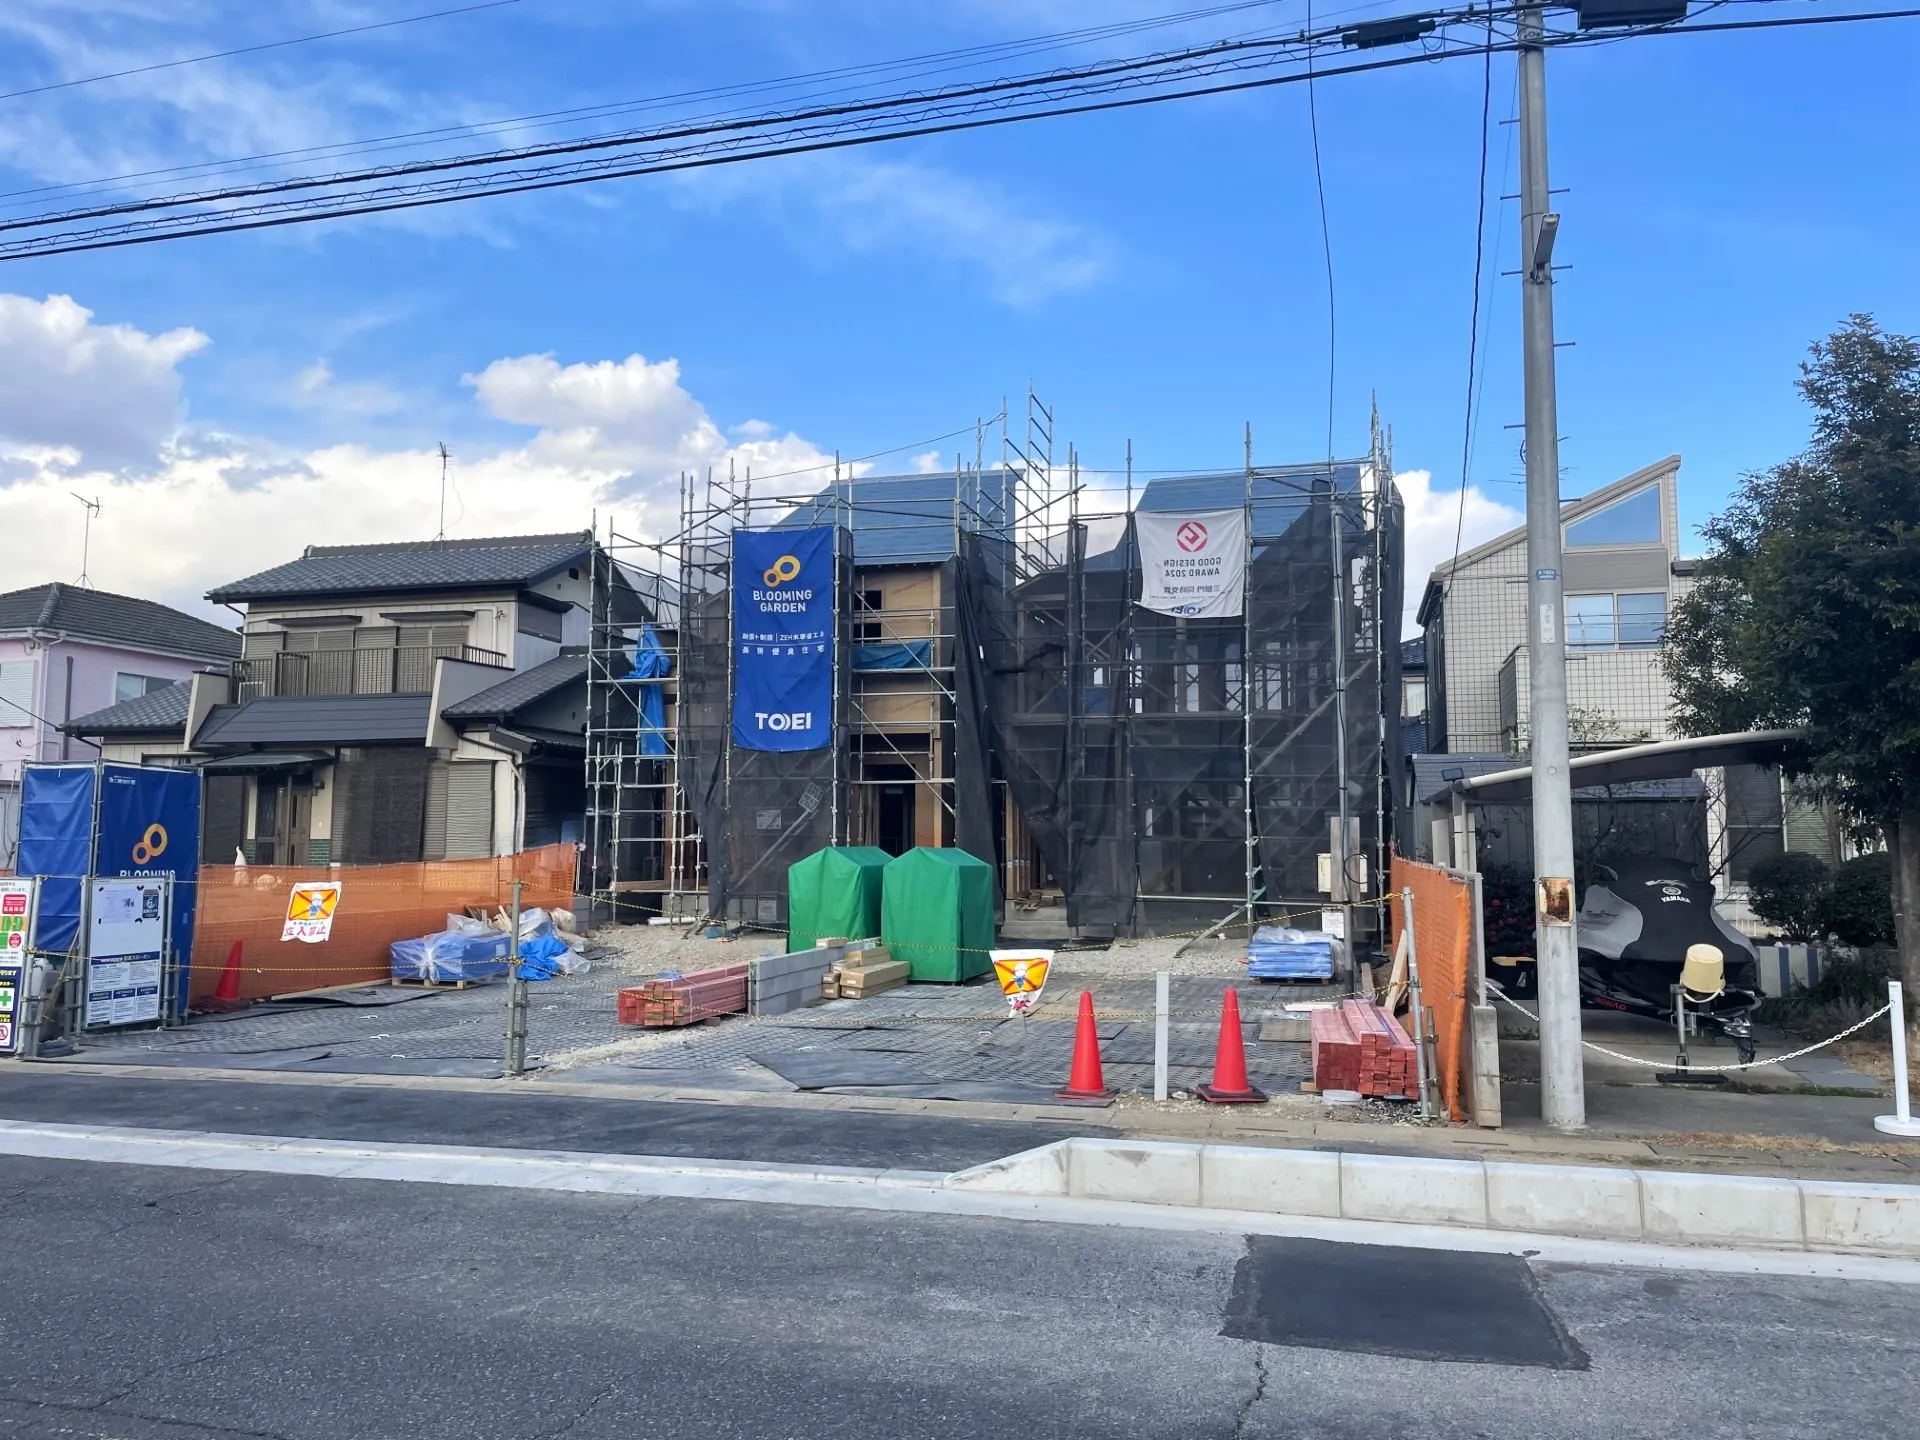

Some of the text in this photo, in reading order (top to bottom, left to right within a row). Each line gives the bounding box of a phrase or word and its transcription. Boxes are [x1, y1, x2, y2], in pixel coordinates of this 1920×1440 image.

[753, 590, 812, 601] BLOOMING
[760, 602, 806, 613] GARDEN
[755, 712, 812, 730] TOEI
[286, 925, 327, 936] 立入禁止
